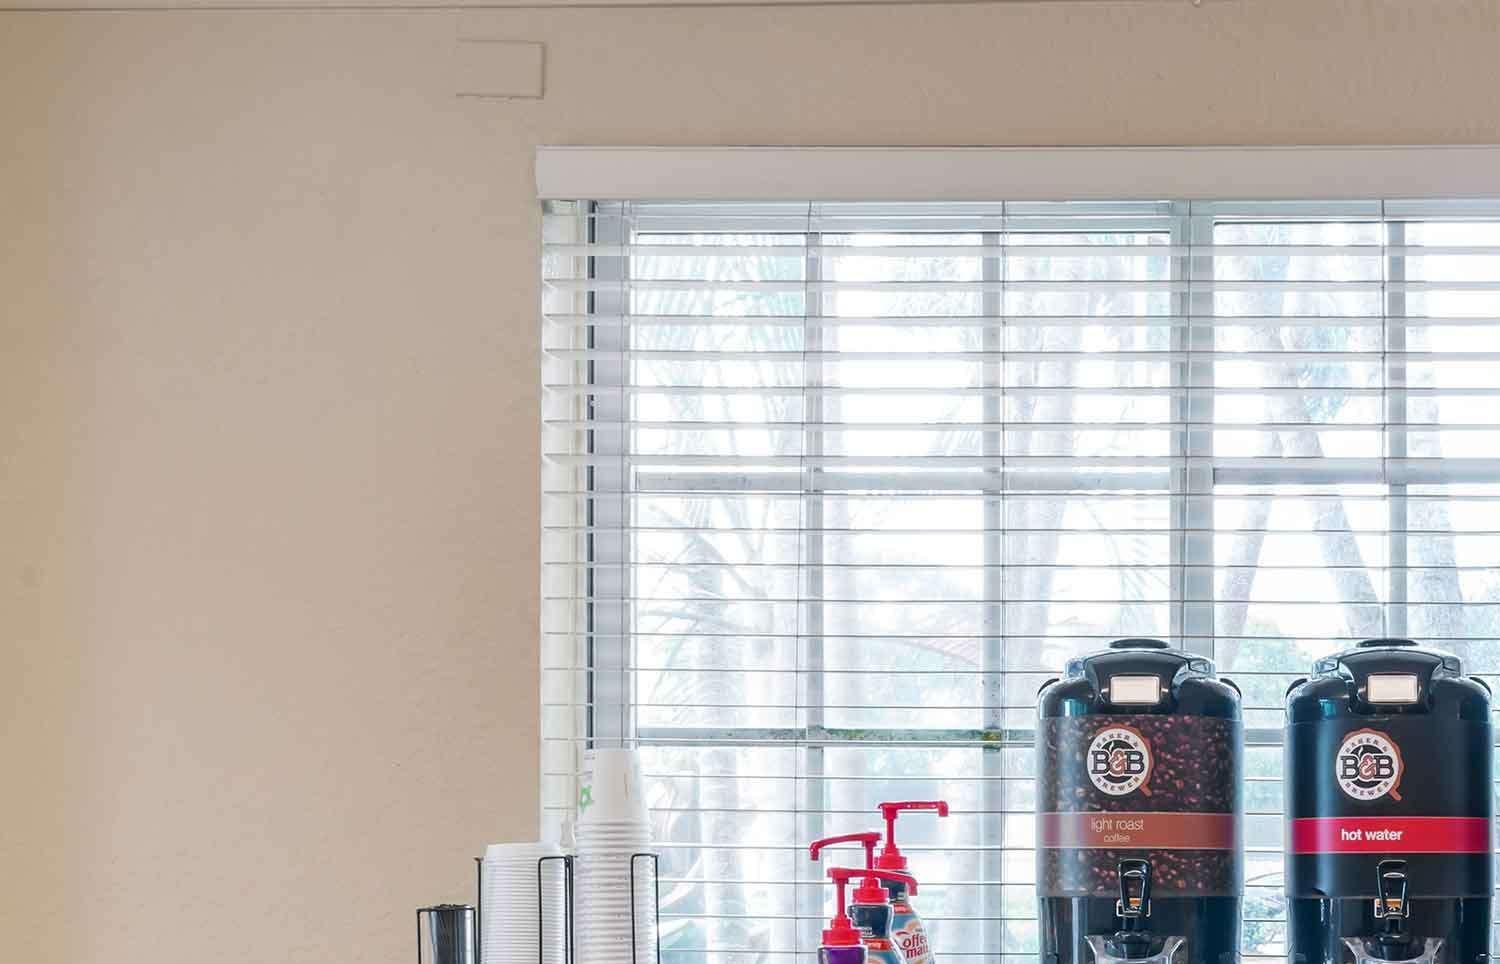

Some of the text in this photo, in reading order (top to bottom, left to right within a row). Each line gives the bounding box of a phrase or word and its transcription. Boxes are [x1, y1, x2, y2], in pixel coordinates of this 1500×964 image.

[1091, 749, 1145, 775] B&B
[1340, 753, 1395, 780] B&B
[1091, 818, 1145, 833] light roast
[1103, 834, 1130, 843] coffee
[1341, 828, 1403, 841] hot water
